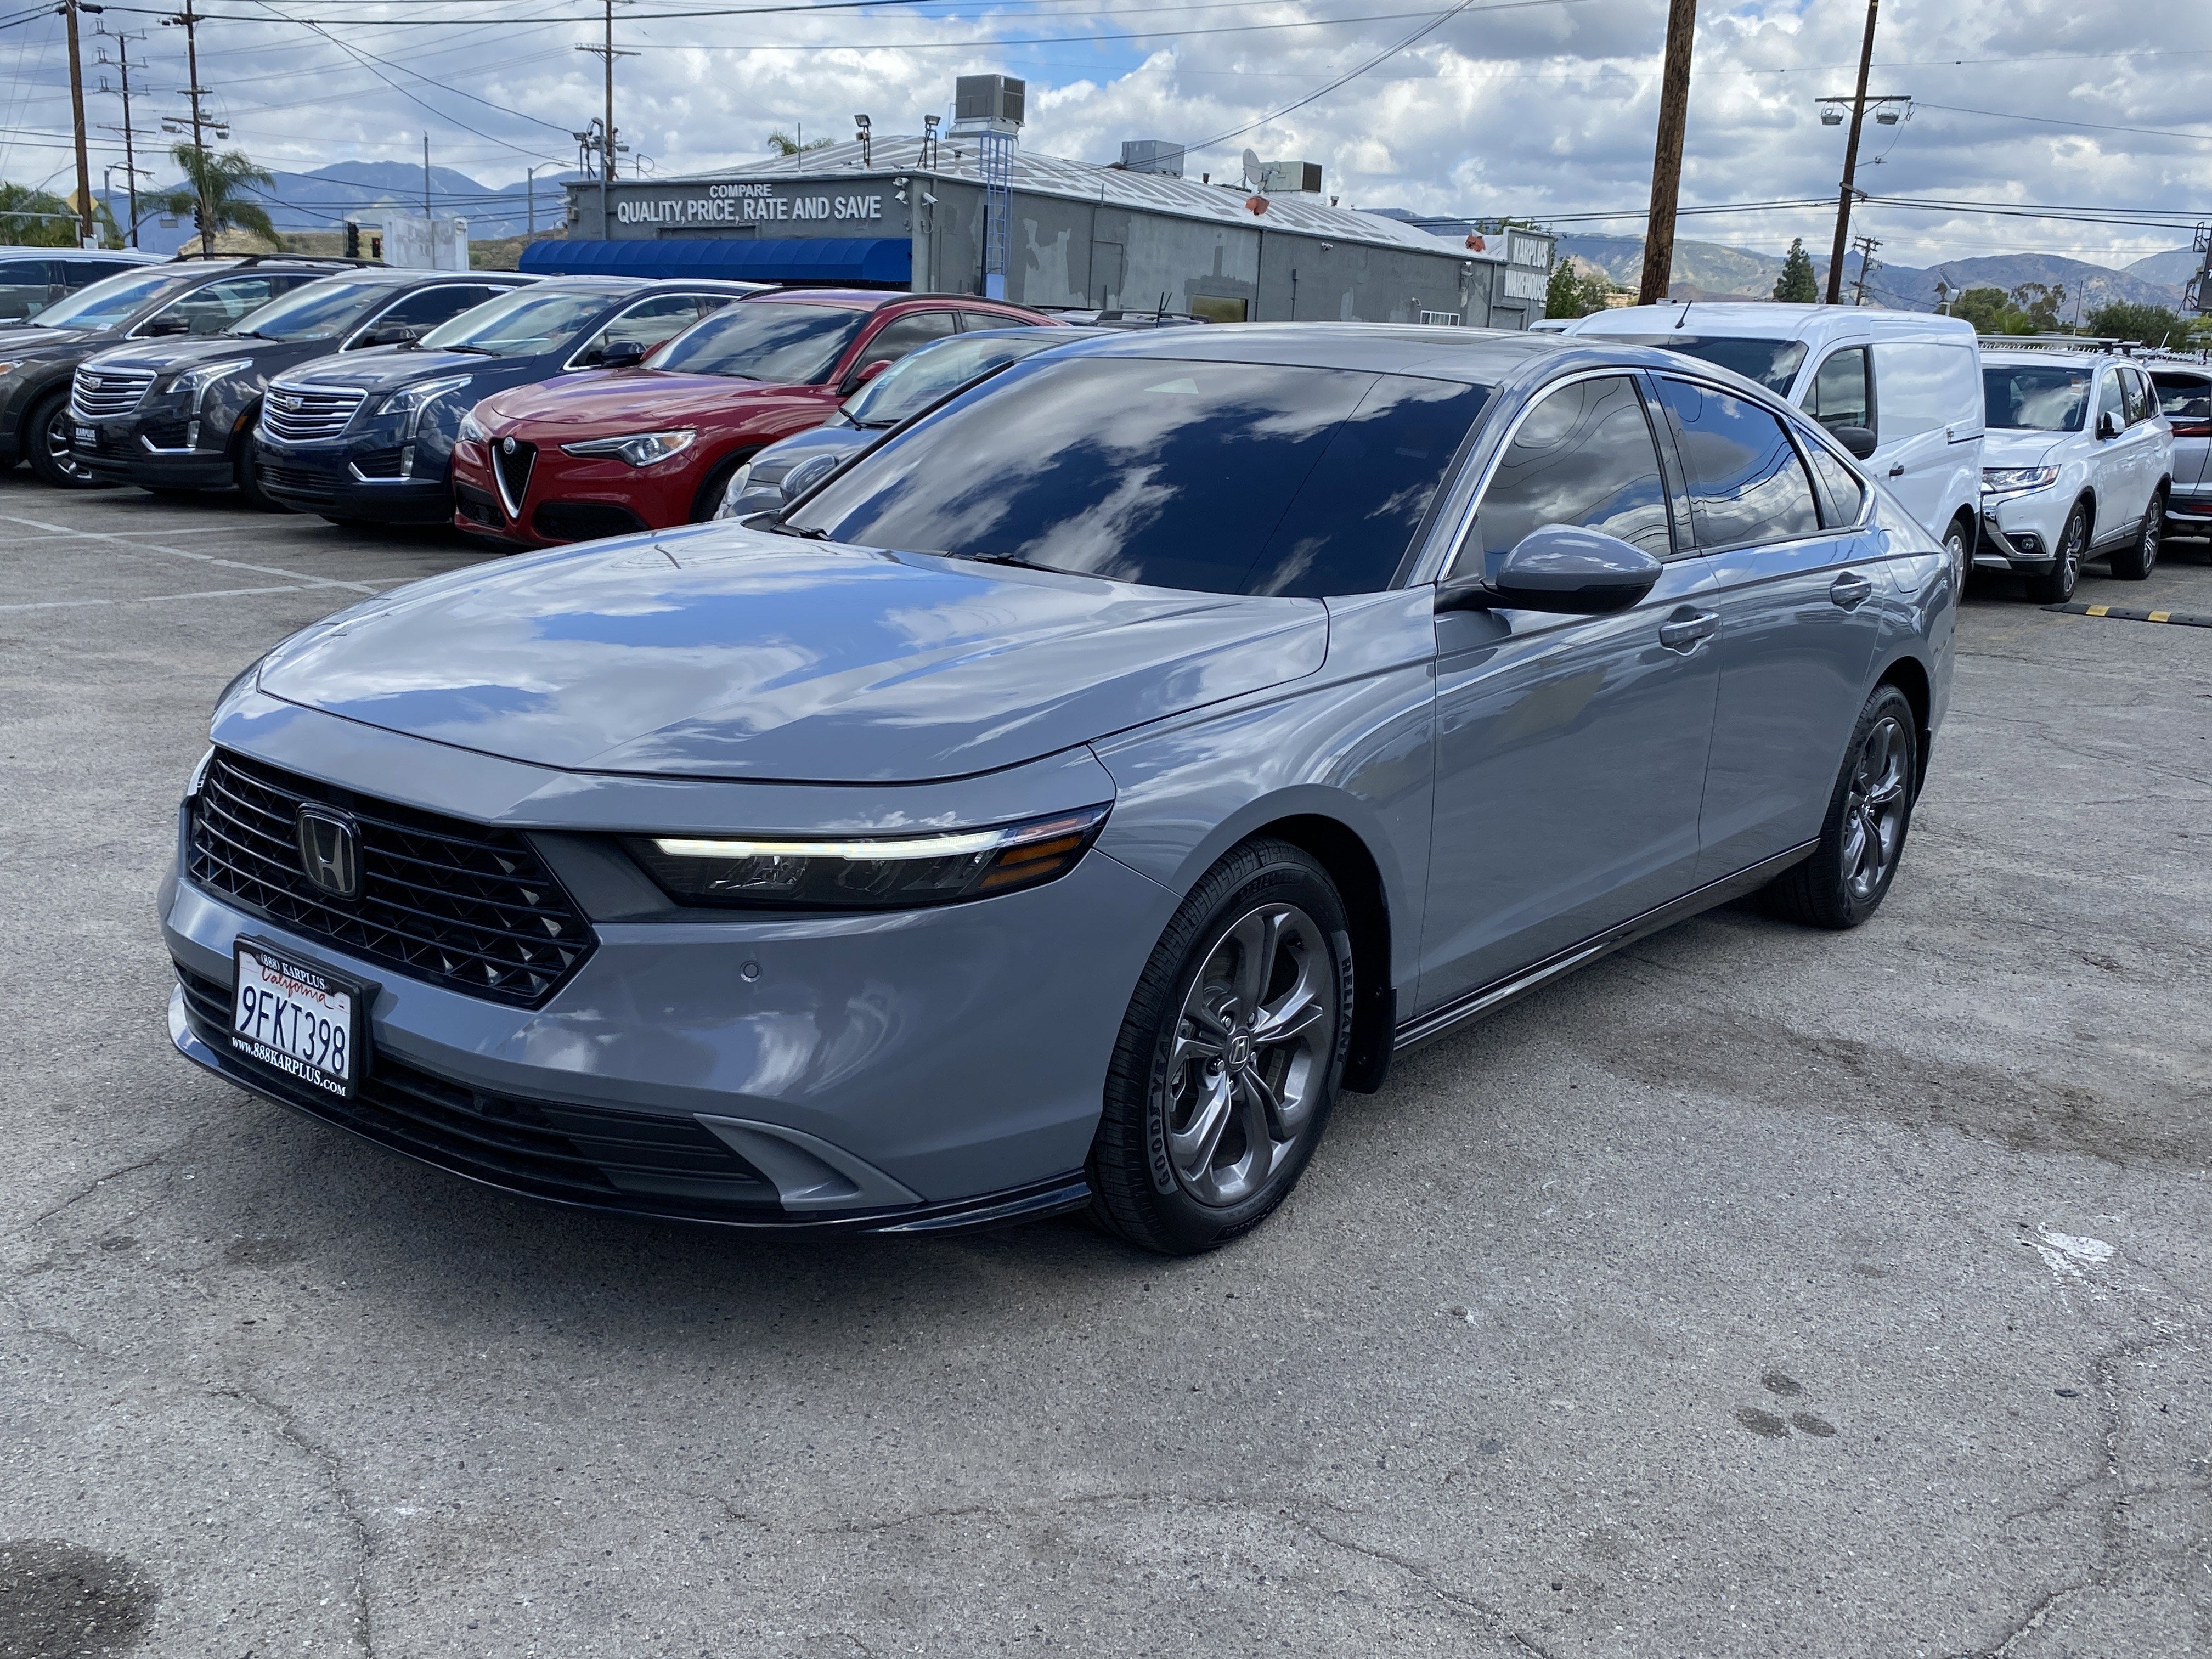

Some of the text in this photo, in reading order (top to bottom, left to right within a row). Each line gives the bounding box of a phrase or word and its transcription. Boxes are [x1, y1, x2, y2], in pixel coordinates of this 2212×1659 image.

[710, 184, 772, 198] COMPARE
[618, 195, 882, 224] QUALITY, PRICE, RATE AND SAVE
[1513, 237, 1548, 268] KARPLUS
[1504, 269, 1549, 301] WAREHOUSE
[261, 953, 325, 990] (888) KARPLUS
[261, 967, 334, 1009] California
[240, 985, 345, 1074] 9FKT398
